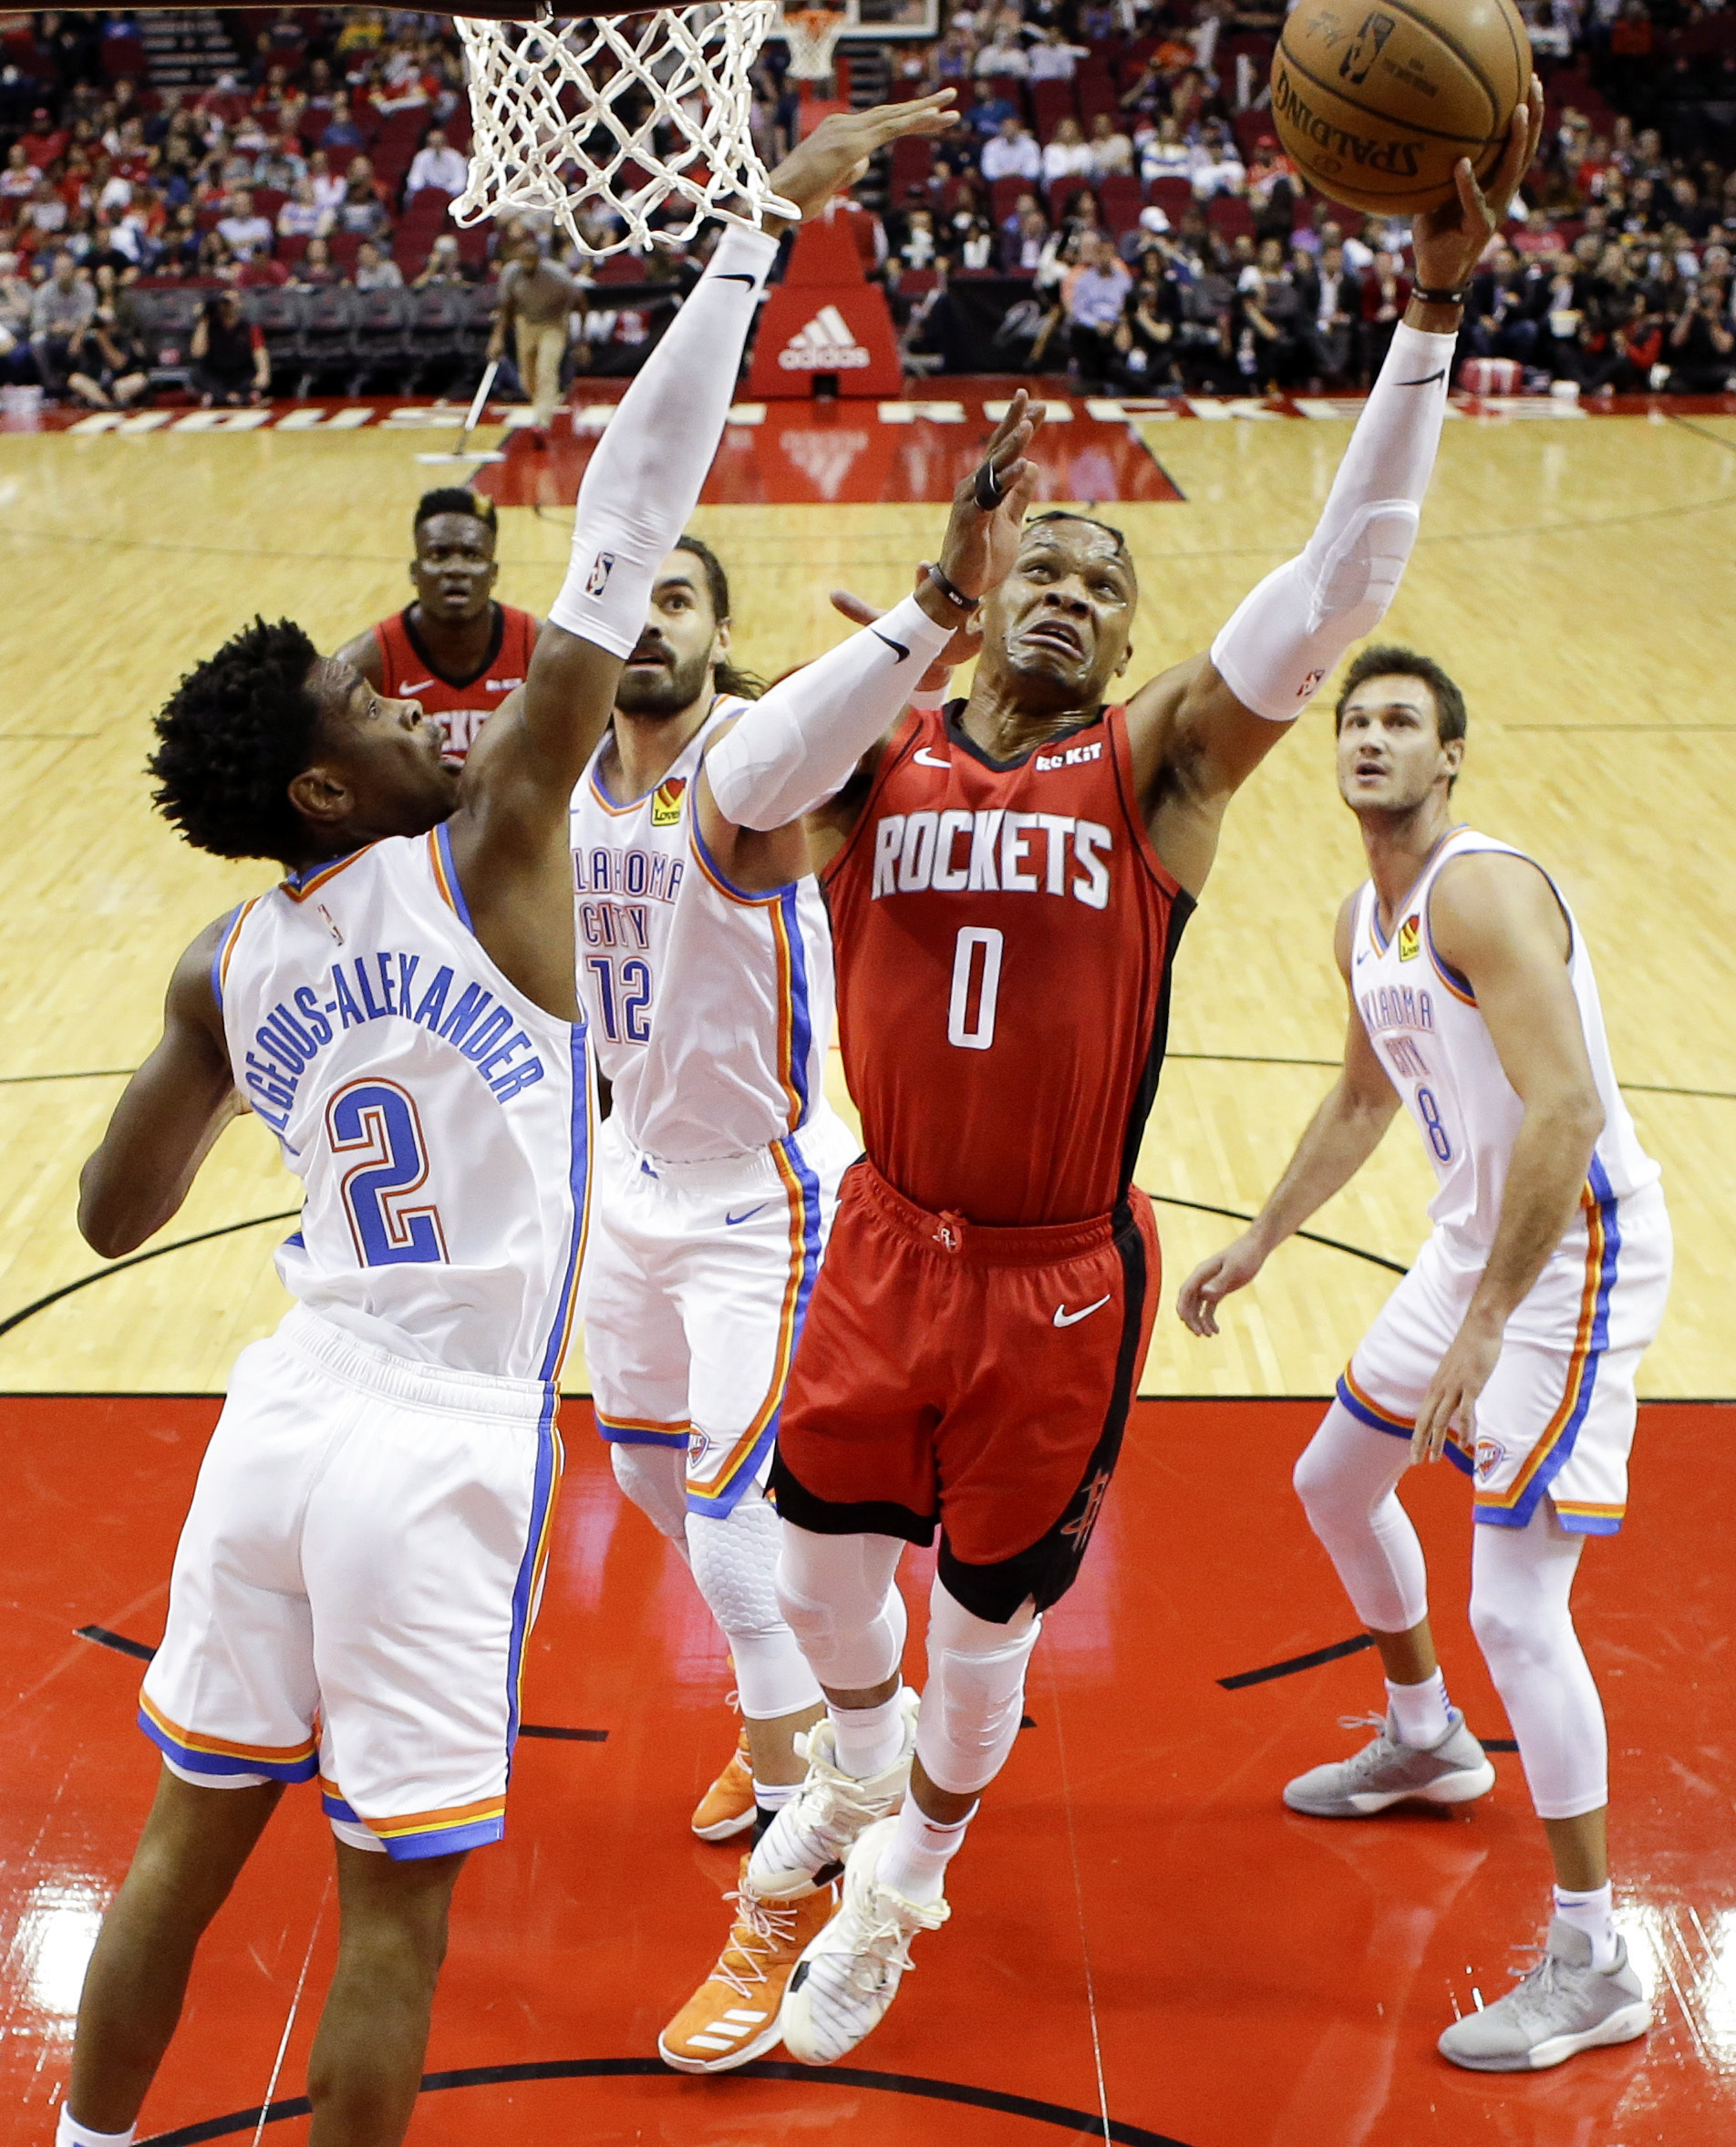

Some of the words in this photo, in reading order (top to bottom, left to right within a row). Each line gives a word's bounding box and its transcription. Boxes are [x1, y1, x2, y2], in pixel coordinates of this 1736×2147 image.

[1275, 69, 1425, 177] SPALDING
[777, 346, 871, 370] adidas
[871, 809, 1113, 911] ROCKETS
[579, 902, 649, 949] CITY
[585, 955, 654, 1047] 12
[947, 925, 1004, 1051] 0
[245, 951, 546, 1156] LGEOUS-ALEXANDER
[325, 1076, 451, 1269] 2
[1414, 1082, 1453, 1169] 8
